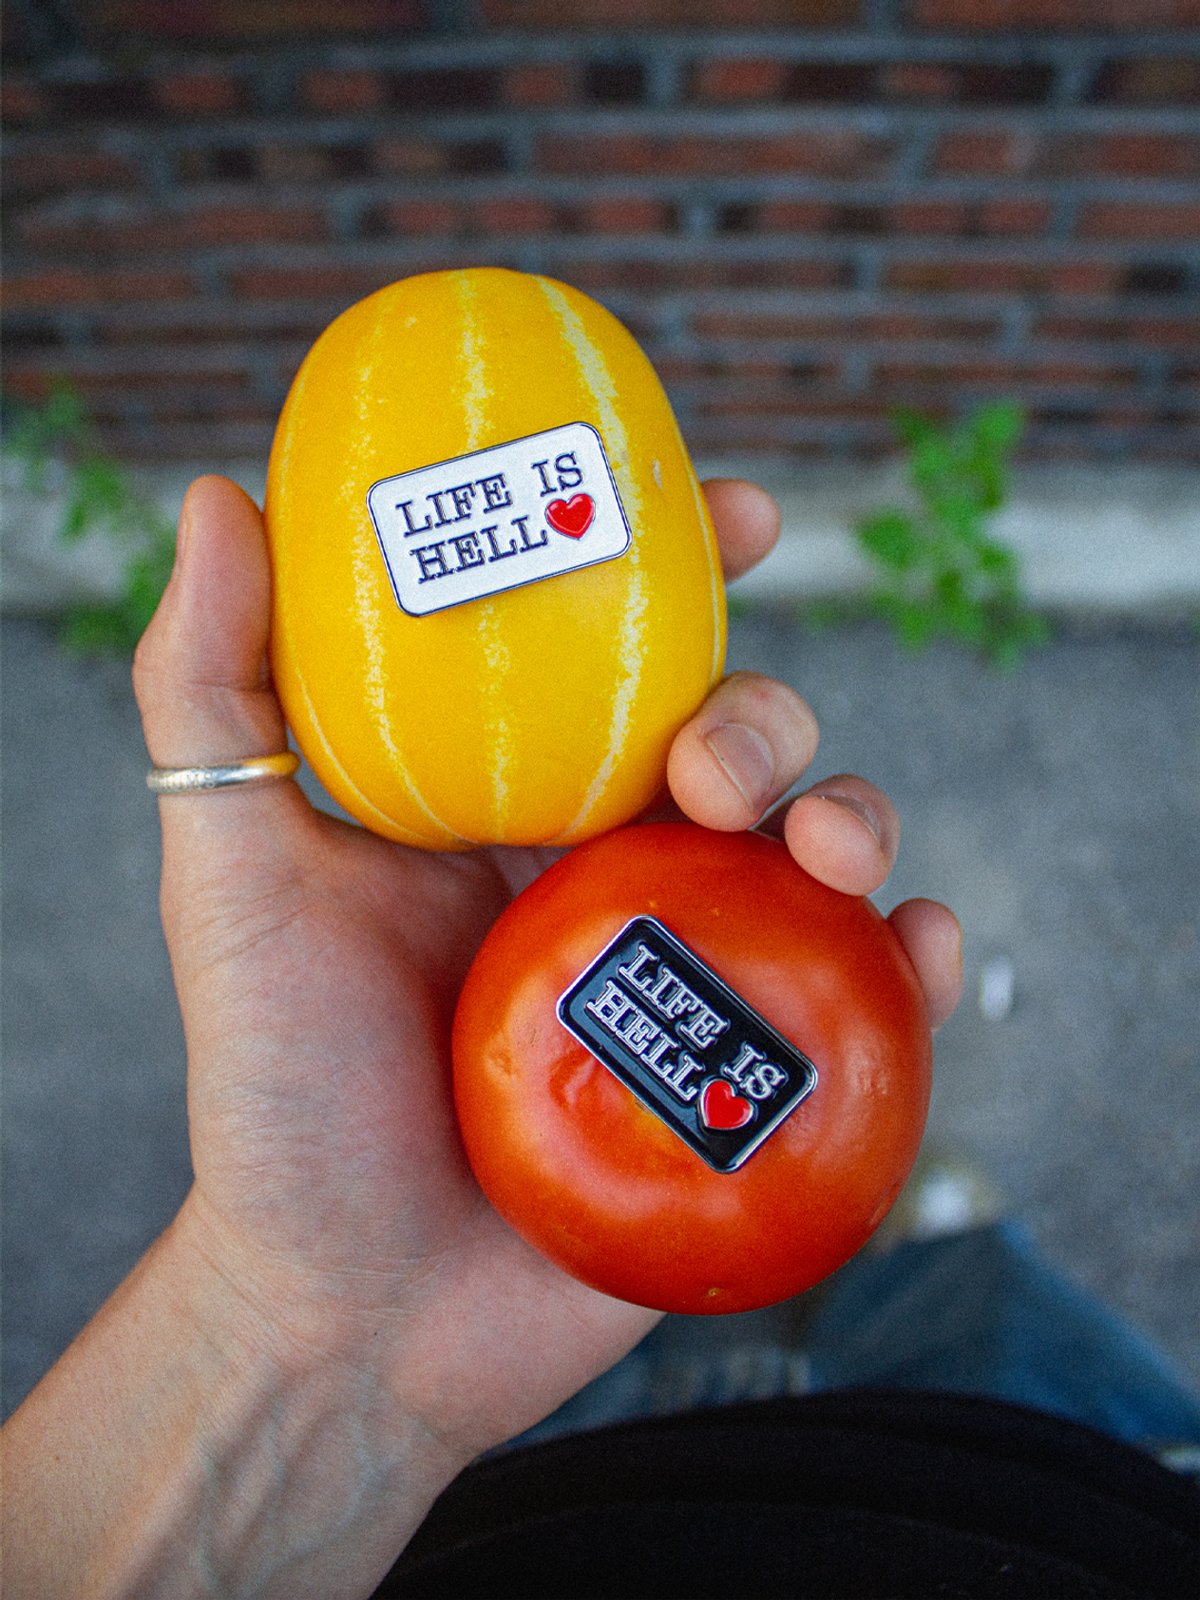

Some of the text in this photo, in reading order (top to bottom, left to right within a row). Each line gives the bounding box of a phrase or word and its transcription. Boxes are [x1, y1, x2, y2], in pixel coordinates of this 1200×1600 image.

[395, 451, 585, 538] LIFE IS
[409, 515, 549, 585] HELL
[586, 979, 703, 1101] HELL
[617, 943, 786, 1100] LIFE IS
